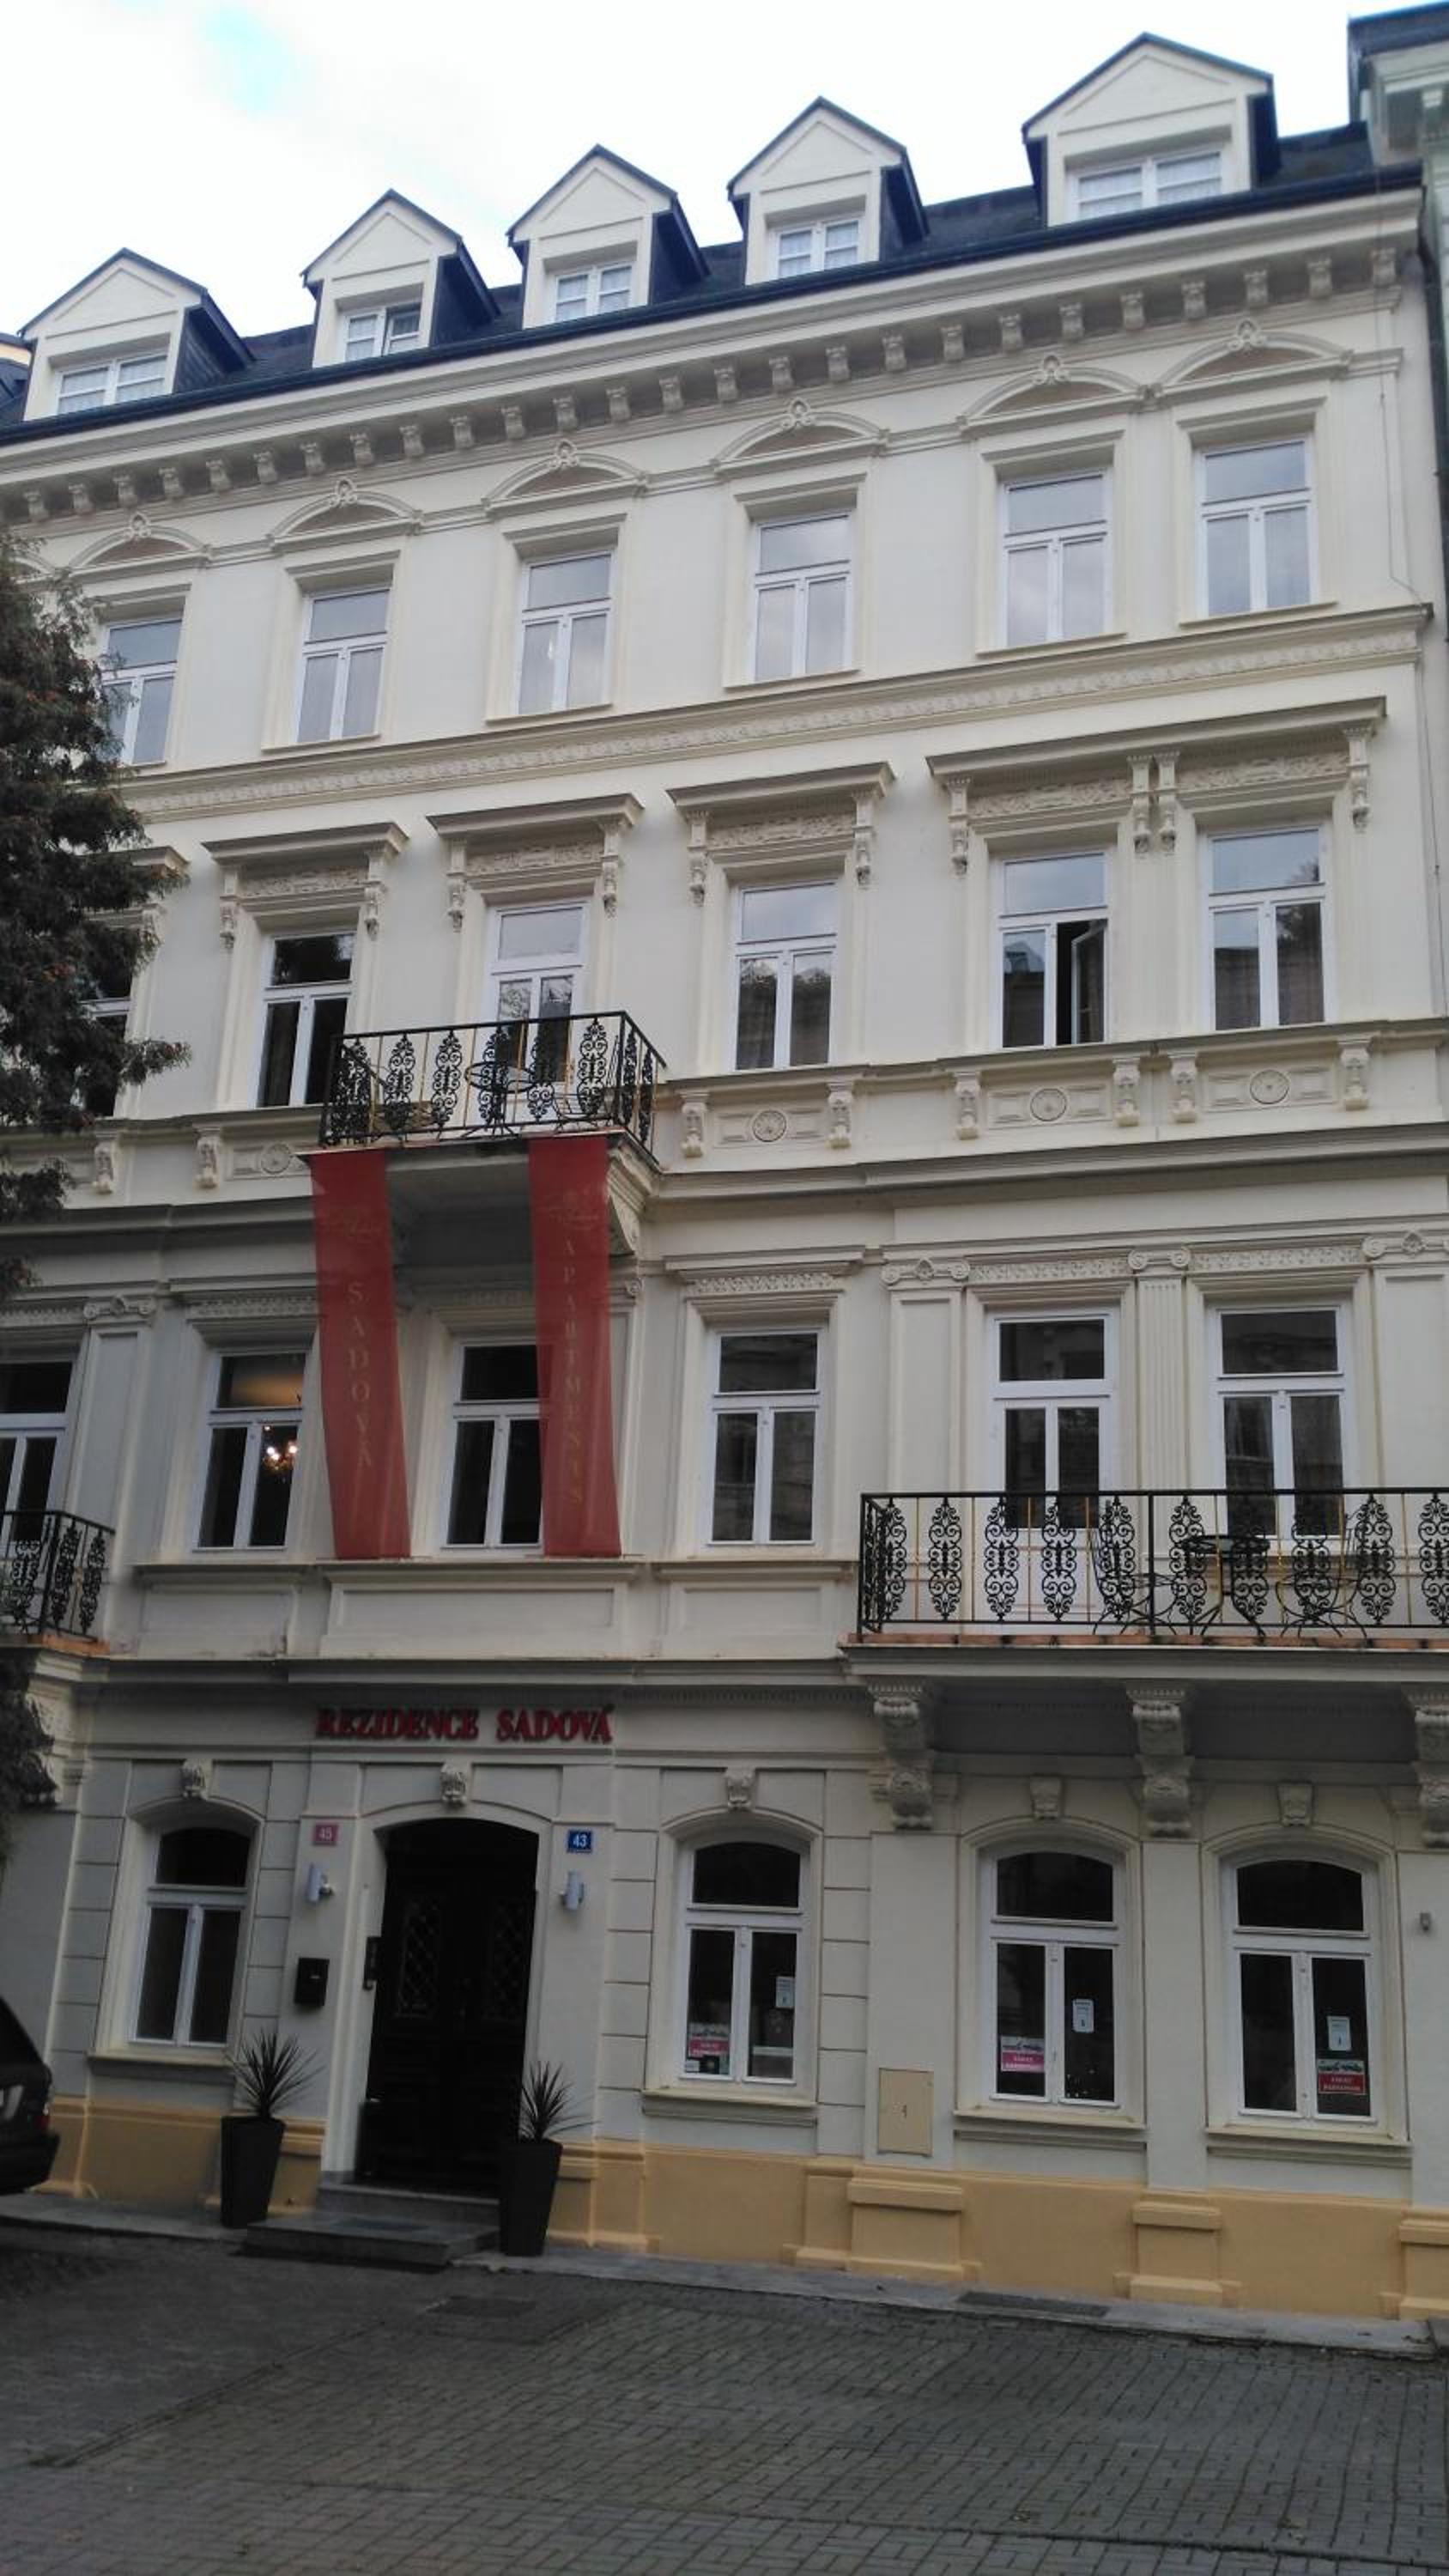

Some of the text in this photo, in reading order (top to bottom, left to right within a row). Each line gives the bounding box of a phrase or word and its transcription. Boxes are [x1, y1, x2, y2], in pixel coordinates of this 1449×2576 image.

[317, 1704, 615, 1743] REZIDENCE SADOVÁ
[573, 1834, 587, 1847] 43
